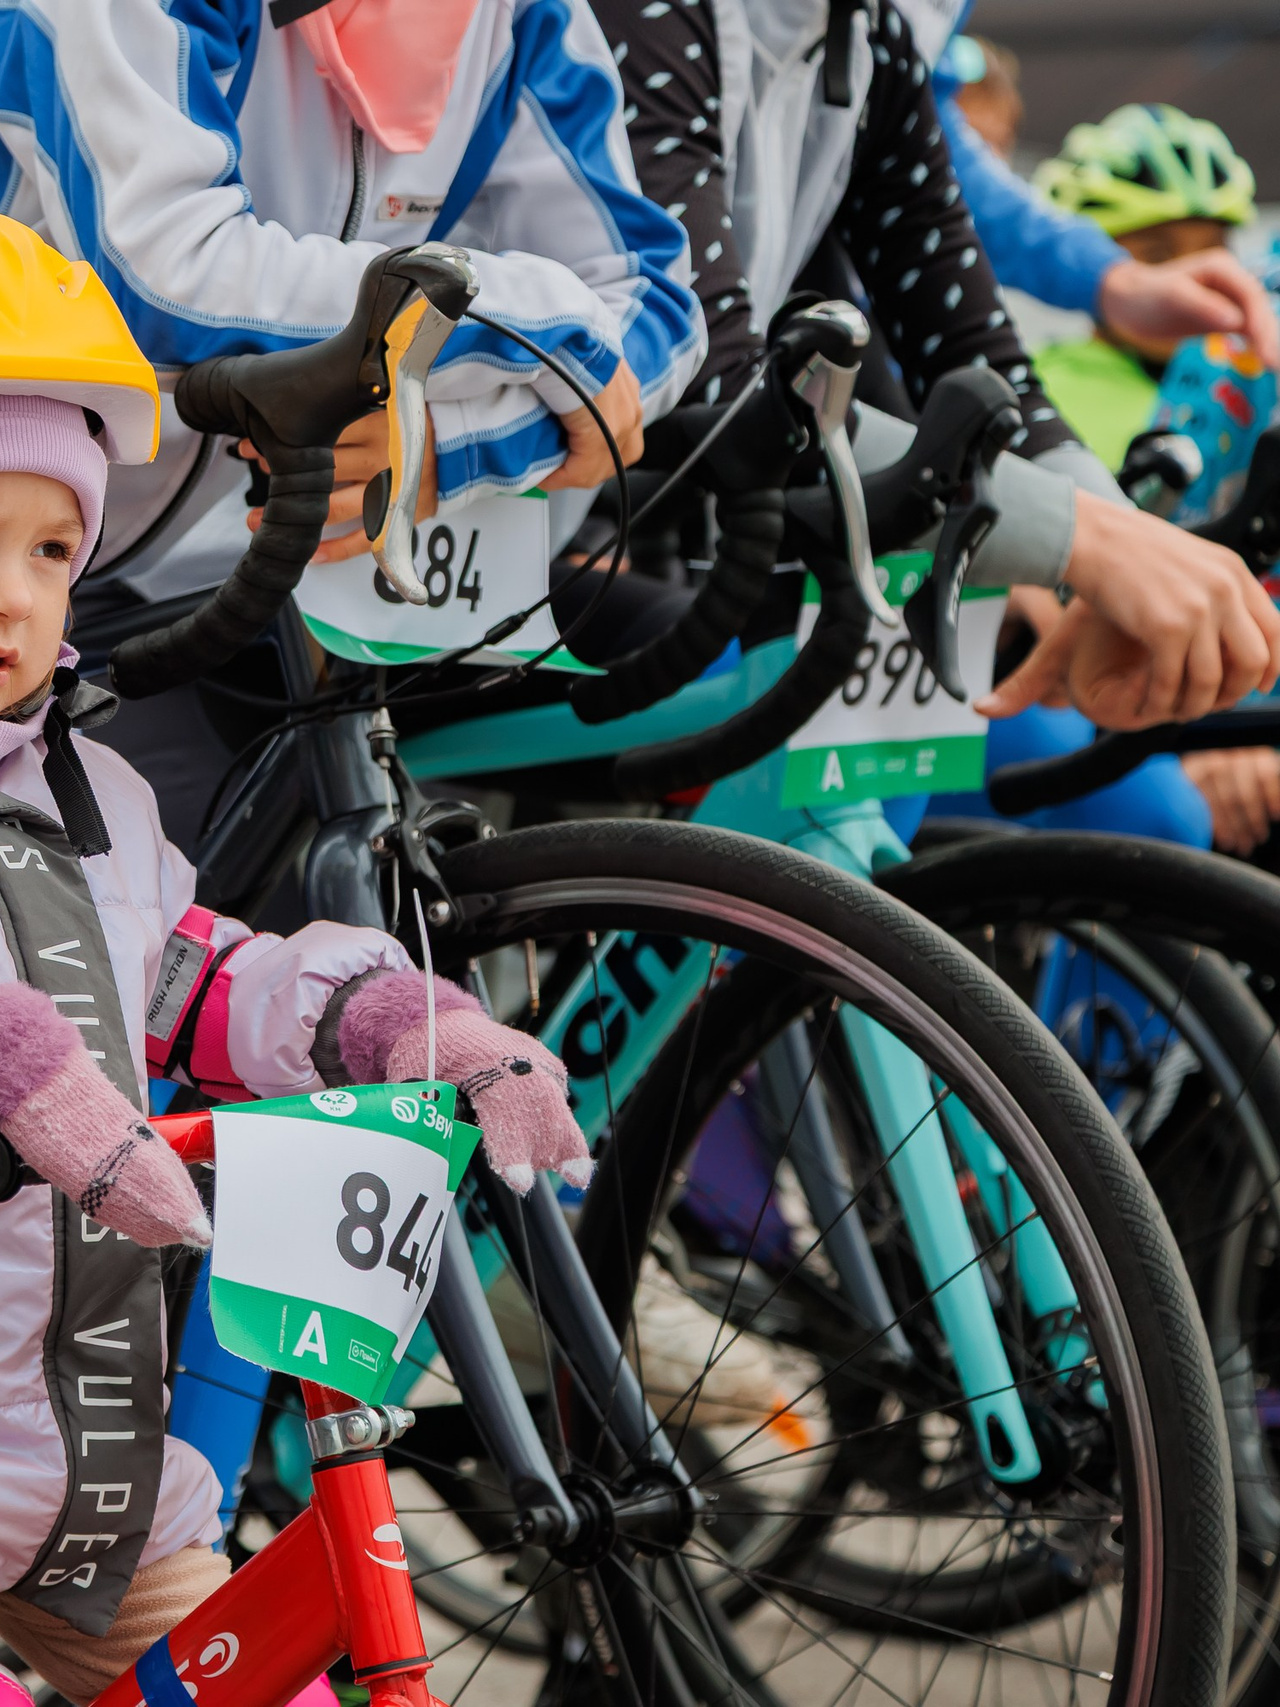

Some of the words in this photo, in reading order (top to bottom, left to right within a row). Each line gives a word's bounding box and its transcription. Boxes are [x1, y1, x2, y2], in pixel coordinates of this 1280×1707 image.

[821, 749, 846, 793] A
[147, 989, 168, 1024] RUSH
[164, 944, 190, 991] ACTION
[319, 1092, 349, 1105] 4,2
[422, 1103, 454, 1140] Зву
[292, 1309, 329, 1366] A
[37, 1317, 137, 1590] VULPES
